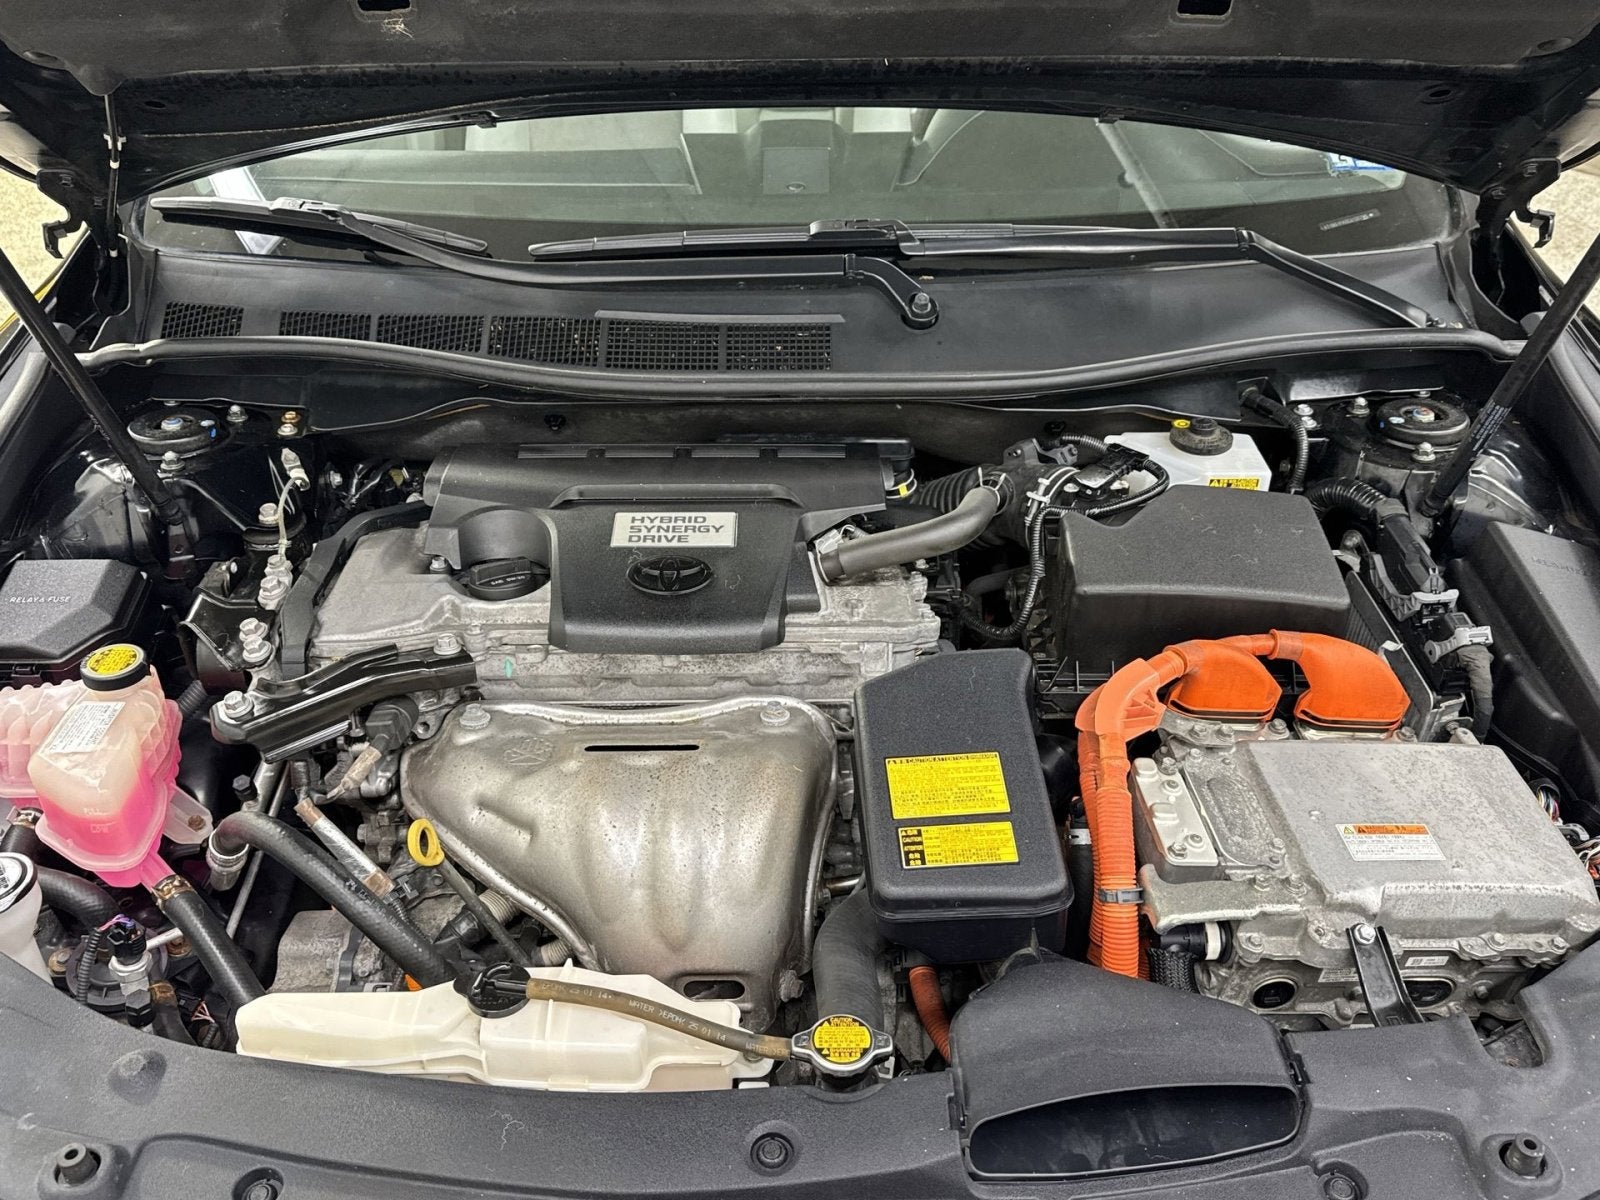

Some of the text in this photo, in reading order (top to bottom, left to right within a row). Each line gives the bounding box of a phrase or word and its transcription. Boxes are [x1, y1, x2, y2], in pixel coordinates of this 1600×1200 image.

[630, 515, 707, 524] HYBRID
[628, 524, 725, 534] SYNERGY
[627, 534, 690, 543] DRIVE
[628, 999, 655, 1014] WATER
[687, 1020, 699, 1032] 25
[701, 1026, 712, 1037] 01
[715, 1030, 727, 1042] 14
